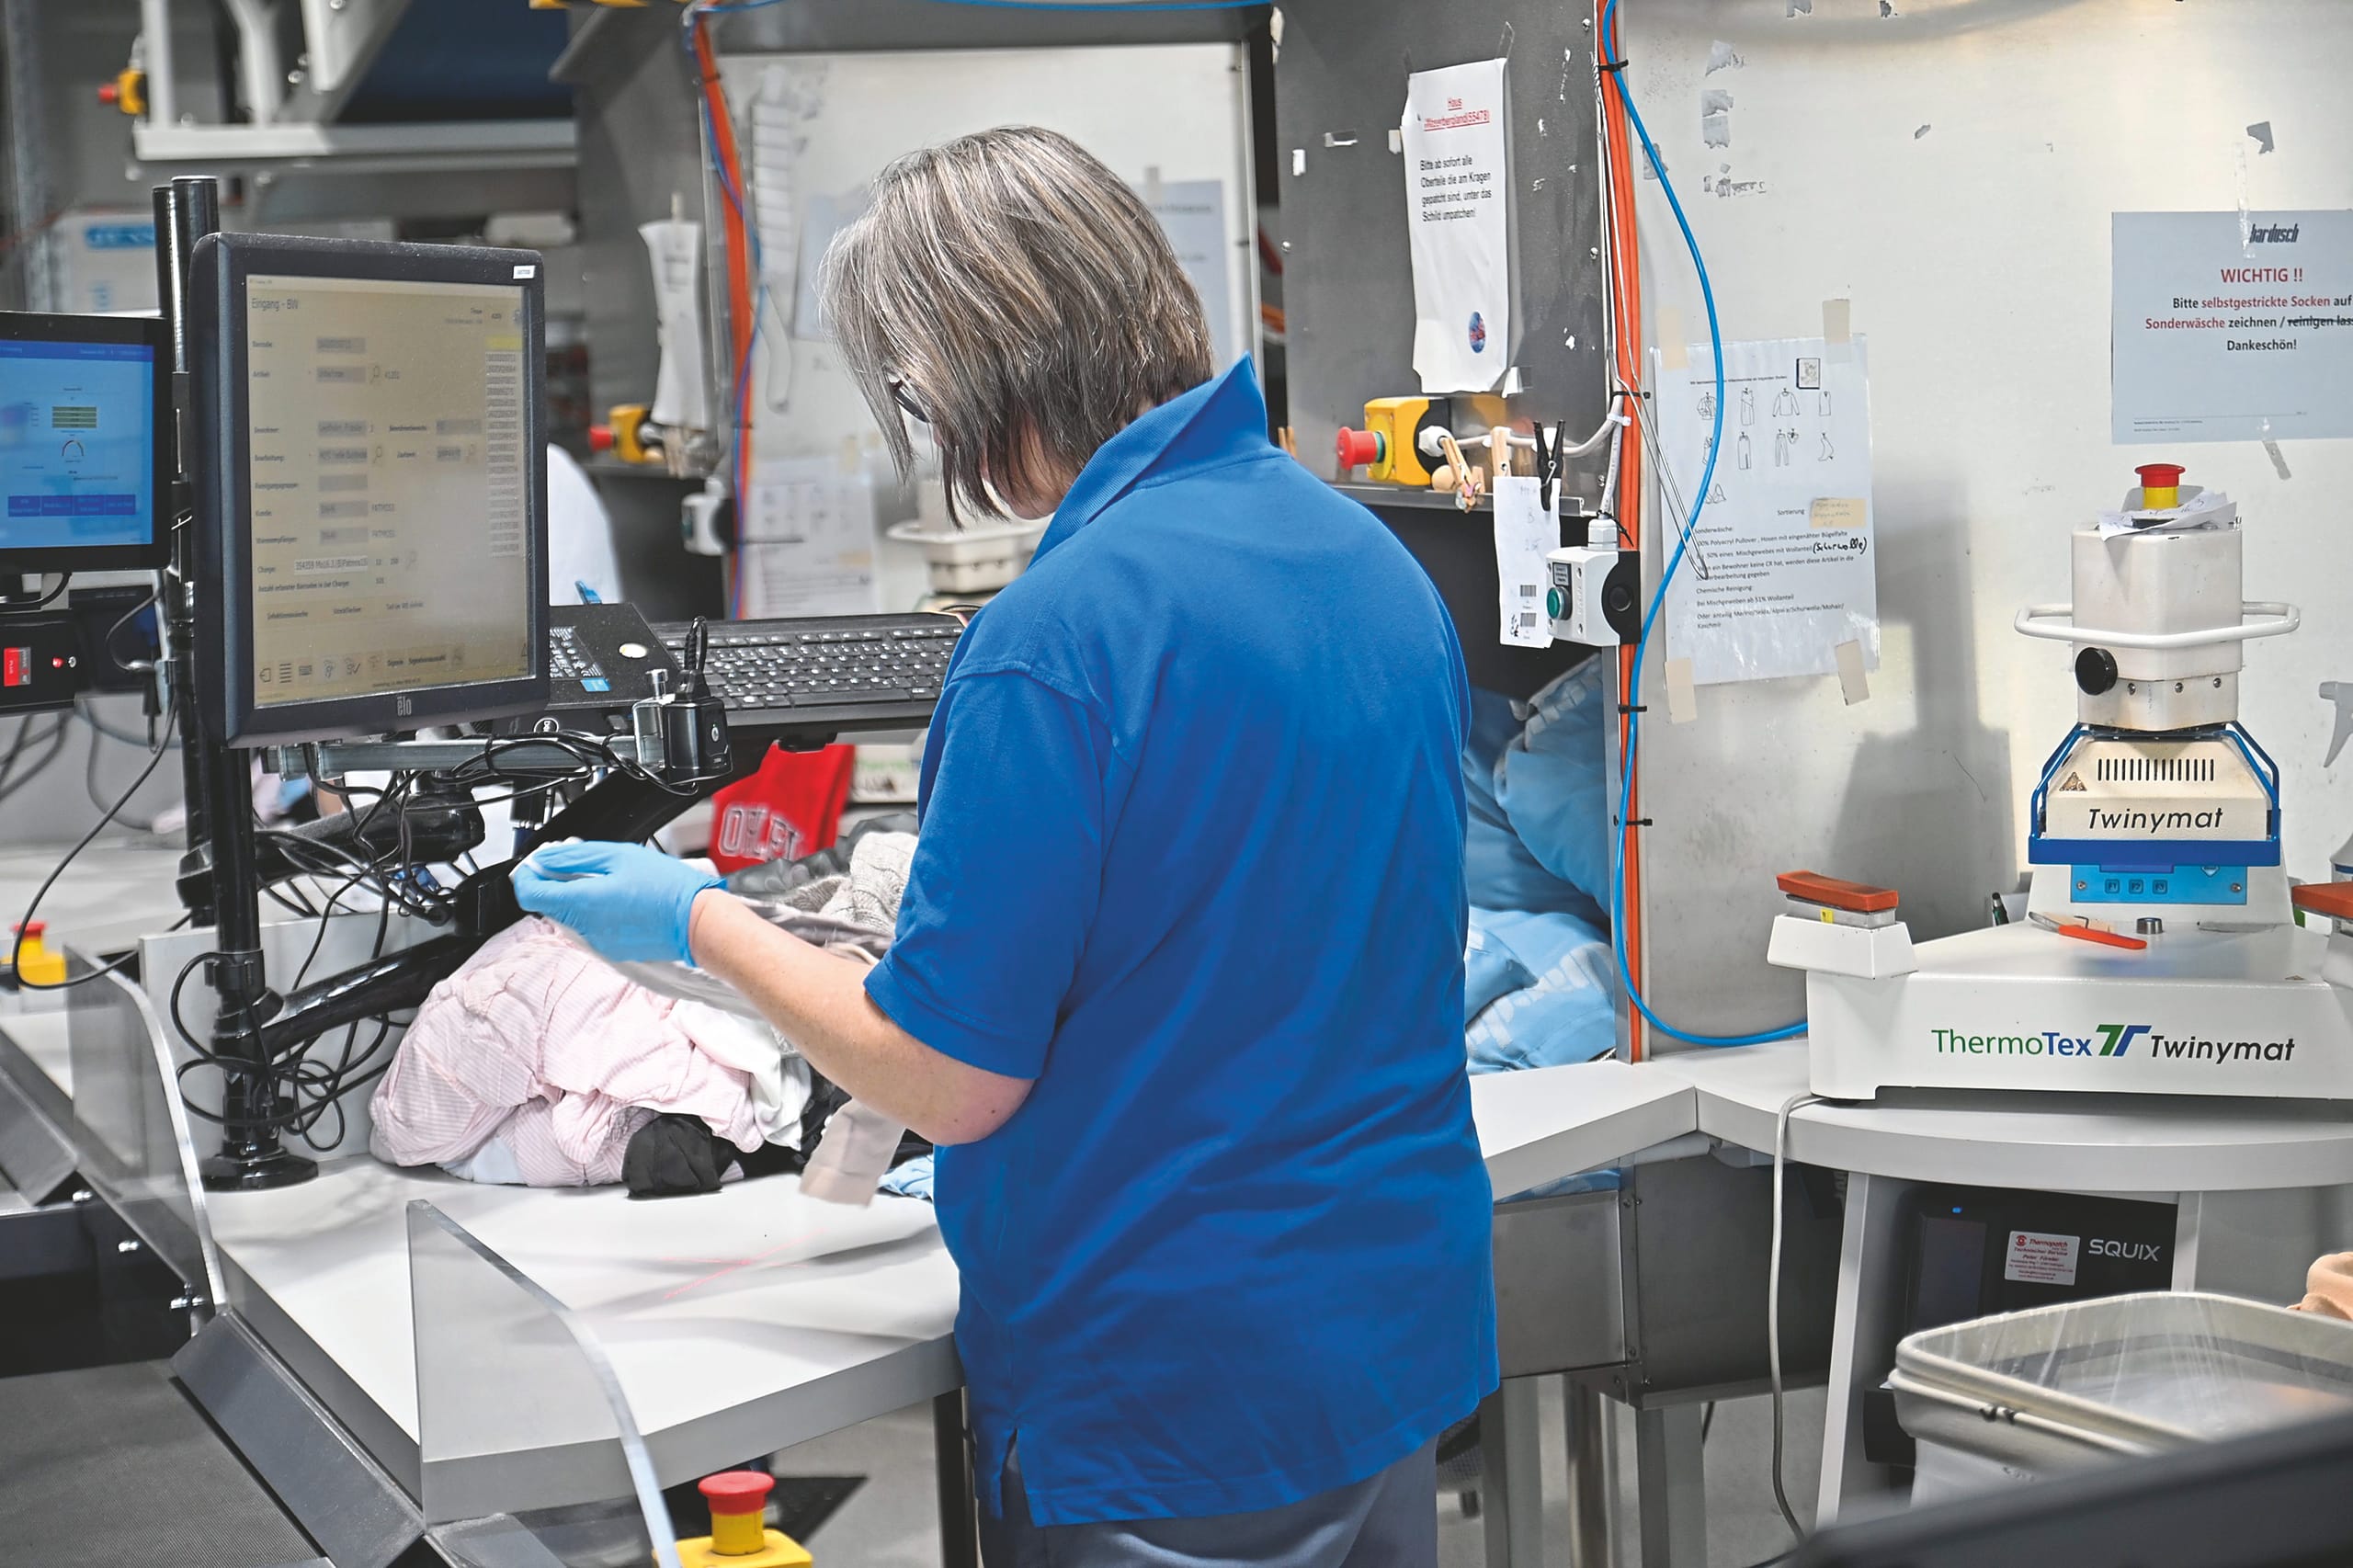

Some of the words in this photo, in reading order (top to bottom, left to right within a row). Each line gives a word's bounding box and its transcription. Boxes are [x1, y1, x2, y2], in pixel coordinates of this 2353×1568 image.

[1420, 159, 1433, 171] Bitte
[1435, 160, 1441, 169] ab
[1443, 157, 1461, 167] sofort
[1469, 173, 1491, 184] Kragen
[1481, 189, 1492, 199] das
[2249, 223, 2299, 243] bardusch
[2221, 268, 2289, 283] WICHTIG
[2293, 268, 2303, 281] !!
[2173, 298, 2199, 308] Bitte
[2201, 296, 2288, 311] selbstgestrickte
[2290, 296, 2331, 307] Socken
[2333, 294, 2352, 305] auf
[2145, 317, 2225, 329] Sonderwäsche
[2228, 316, 2277, 327] zeichnen
[2227, 339, 2297, 351] Dankeschön!
[1778, 508, 1805, 517] Sortierung
[2089, 808, 2223, 834] Twinymat
[1931, 1028, 2093, 1057] ThermoTex
[2151, 1035, 2295, 1064] Twinymat
[2088, 1239, 2161, 1261] SQUIX
